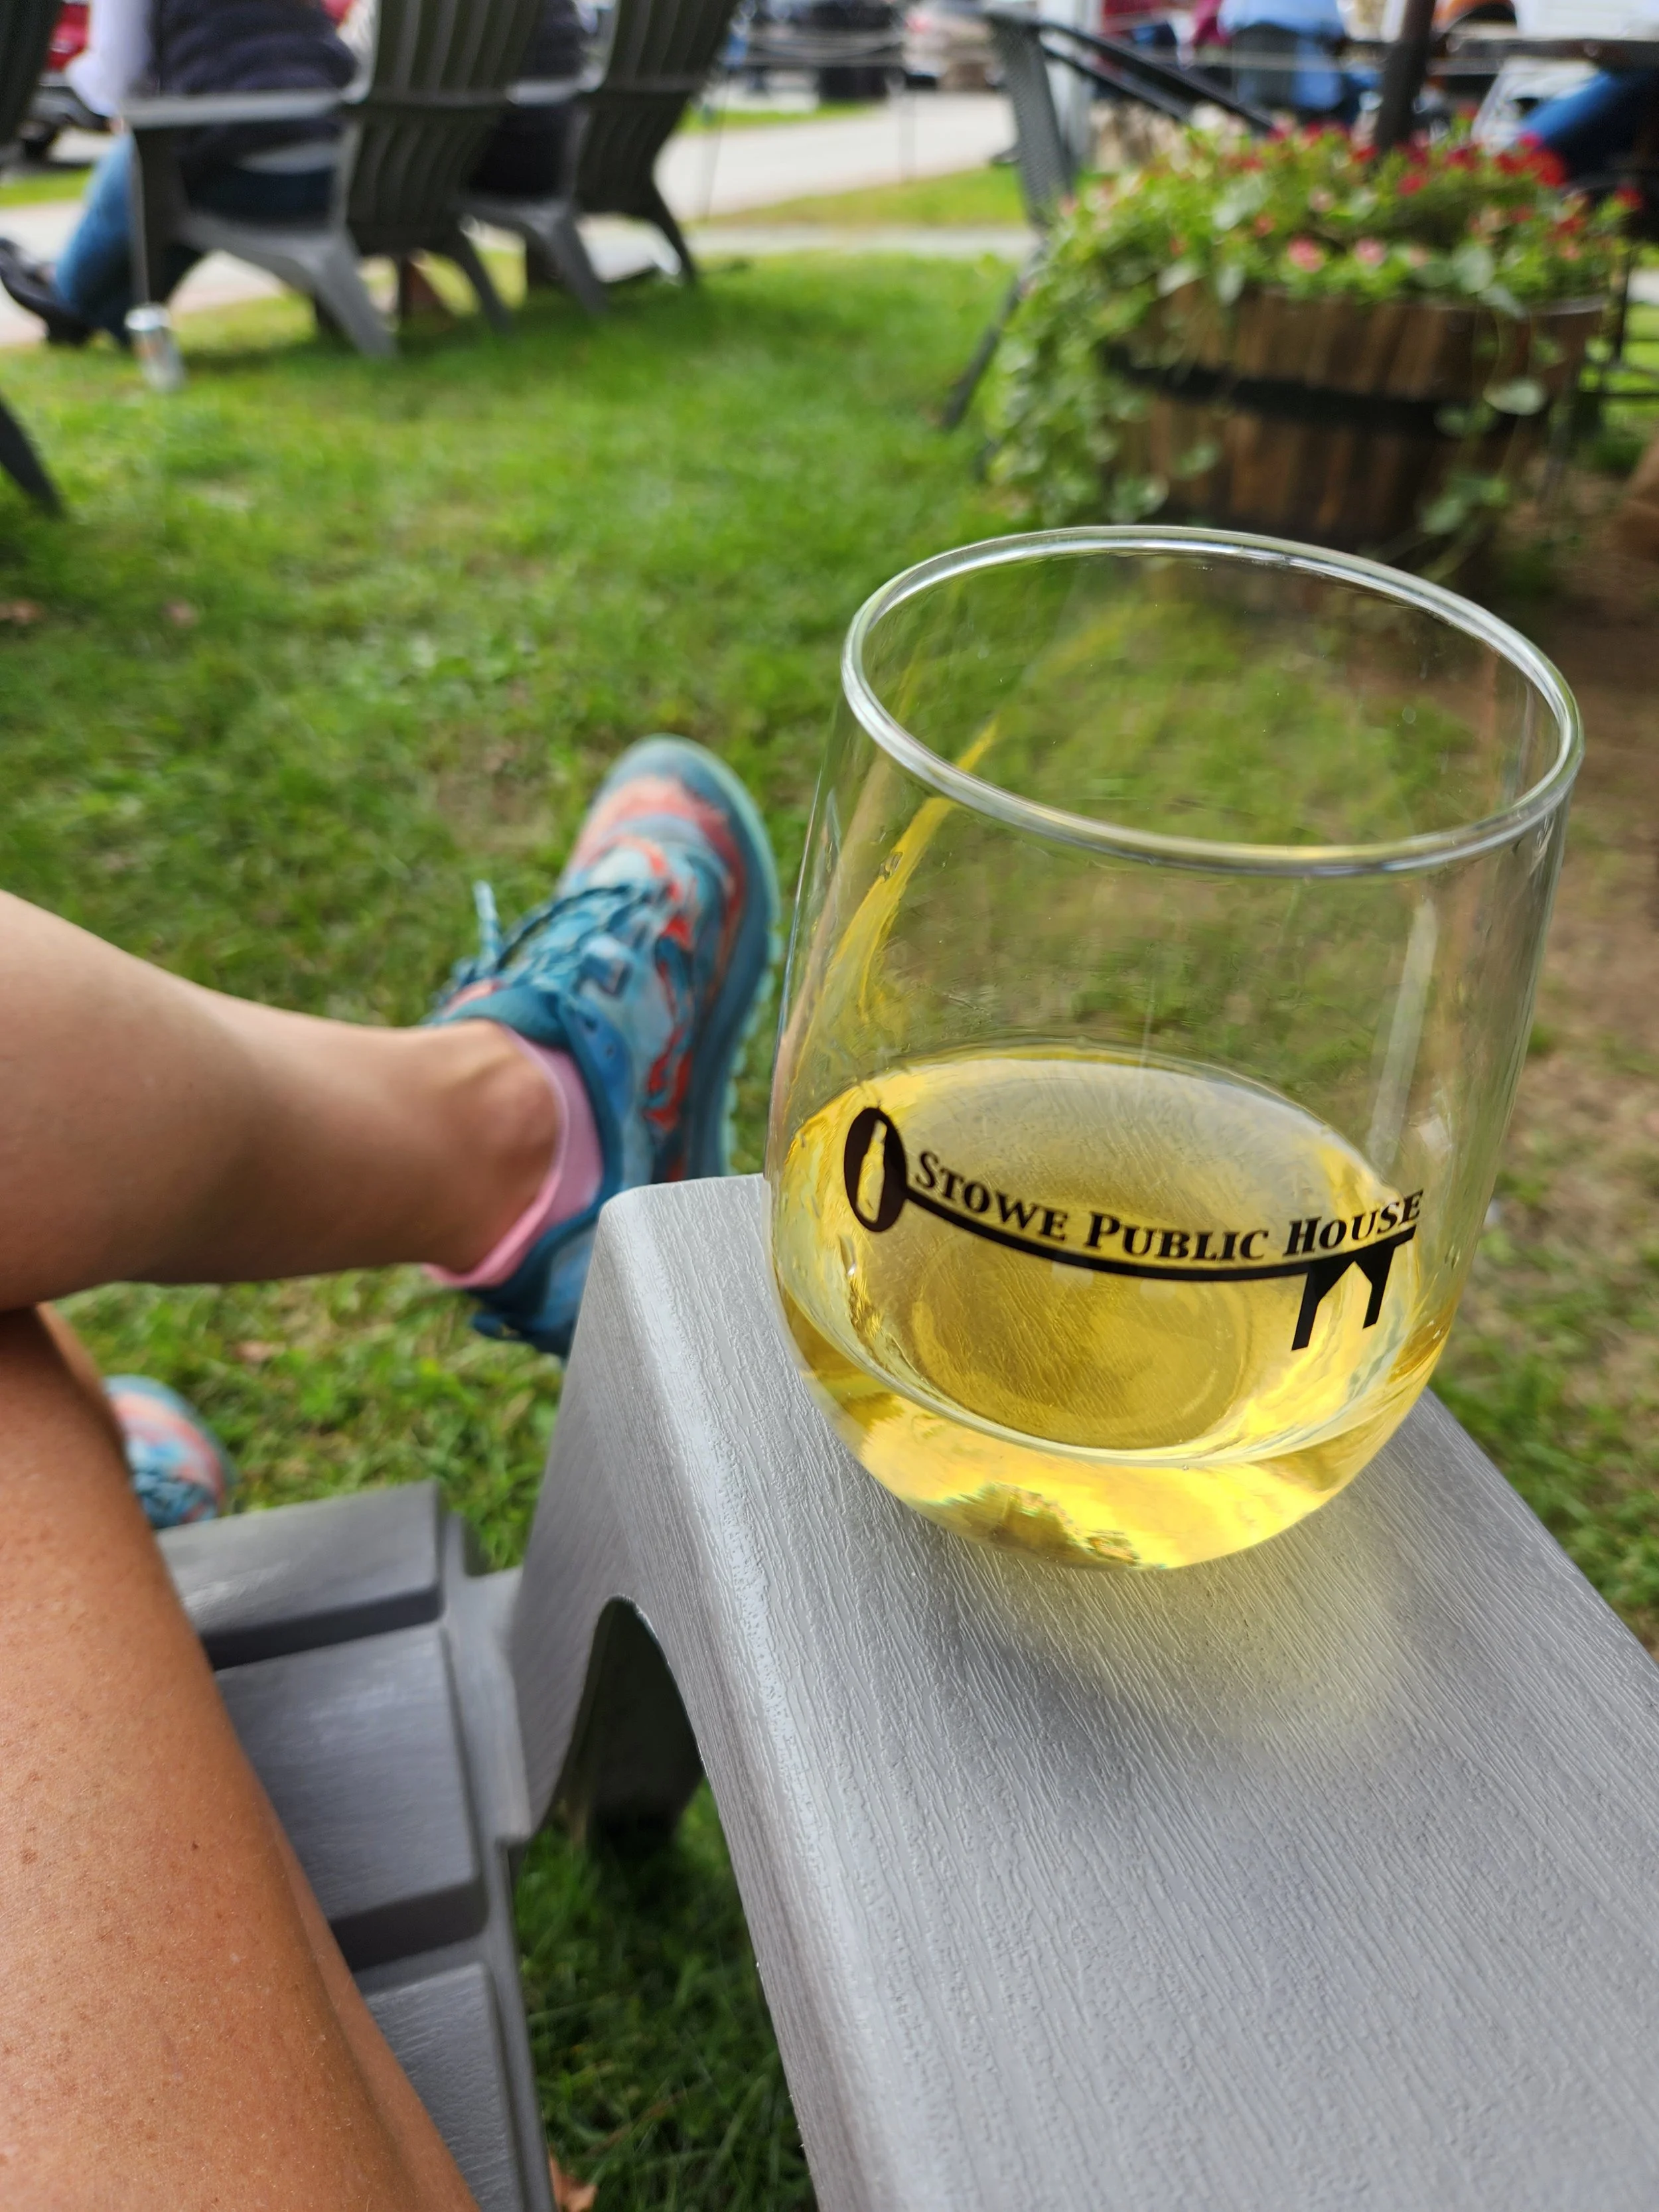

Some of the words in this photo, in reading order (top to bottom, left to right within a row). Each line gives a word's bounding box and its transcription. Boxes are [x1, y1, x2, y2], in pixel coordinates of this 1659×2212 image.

[916, 1151, 1069, 1241] STOWE
[1084, 1211, 1269, 1261] PUBLIC
[1282, 1189, 1424, 1256] HOUSE
